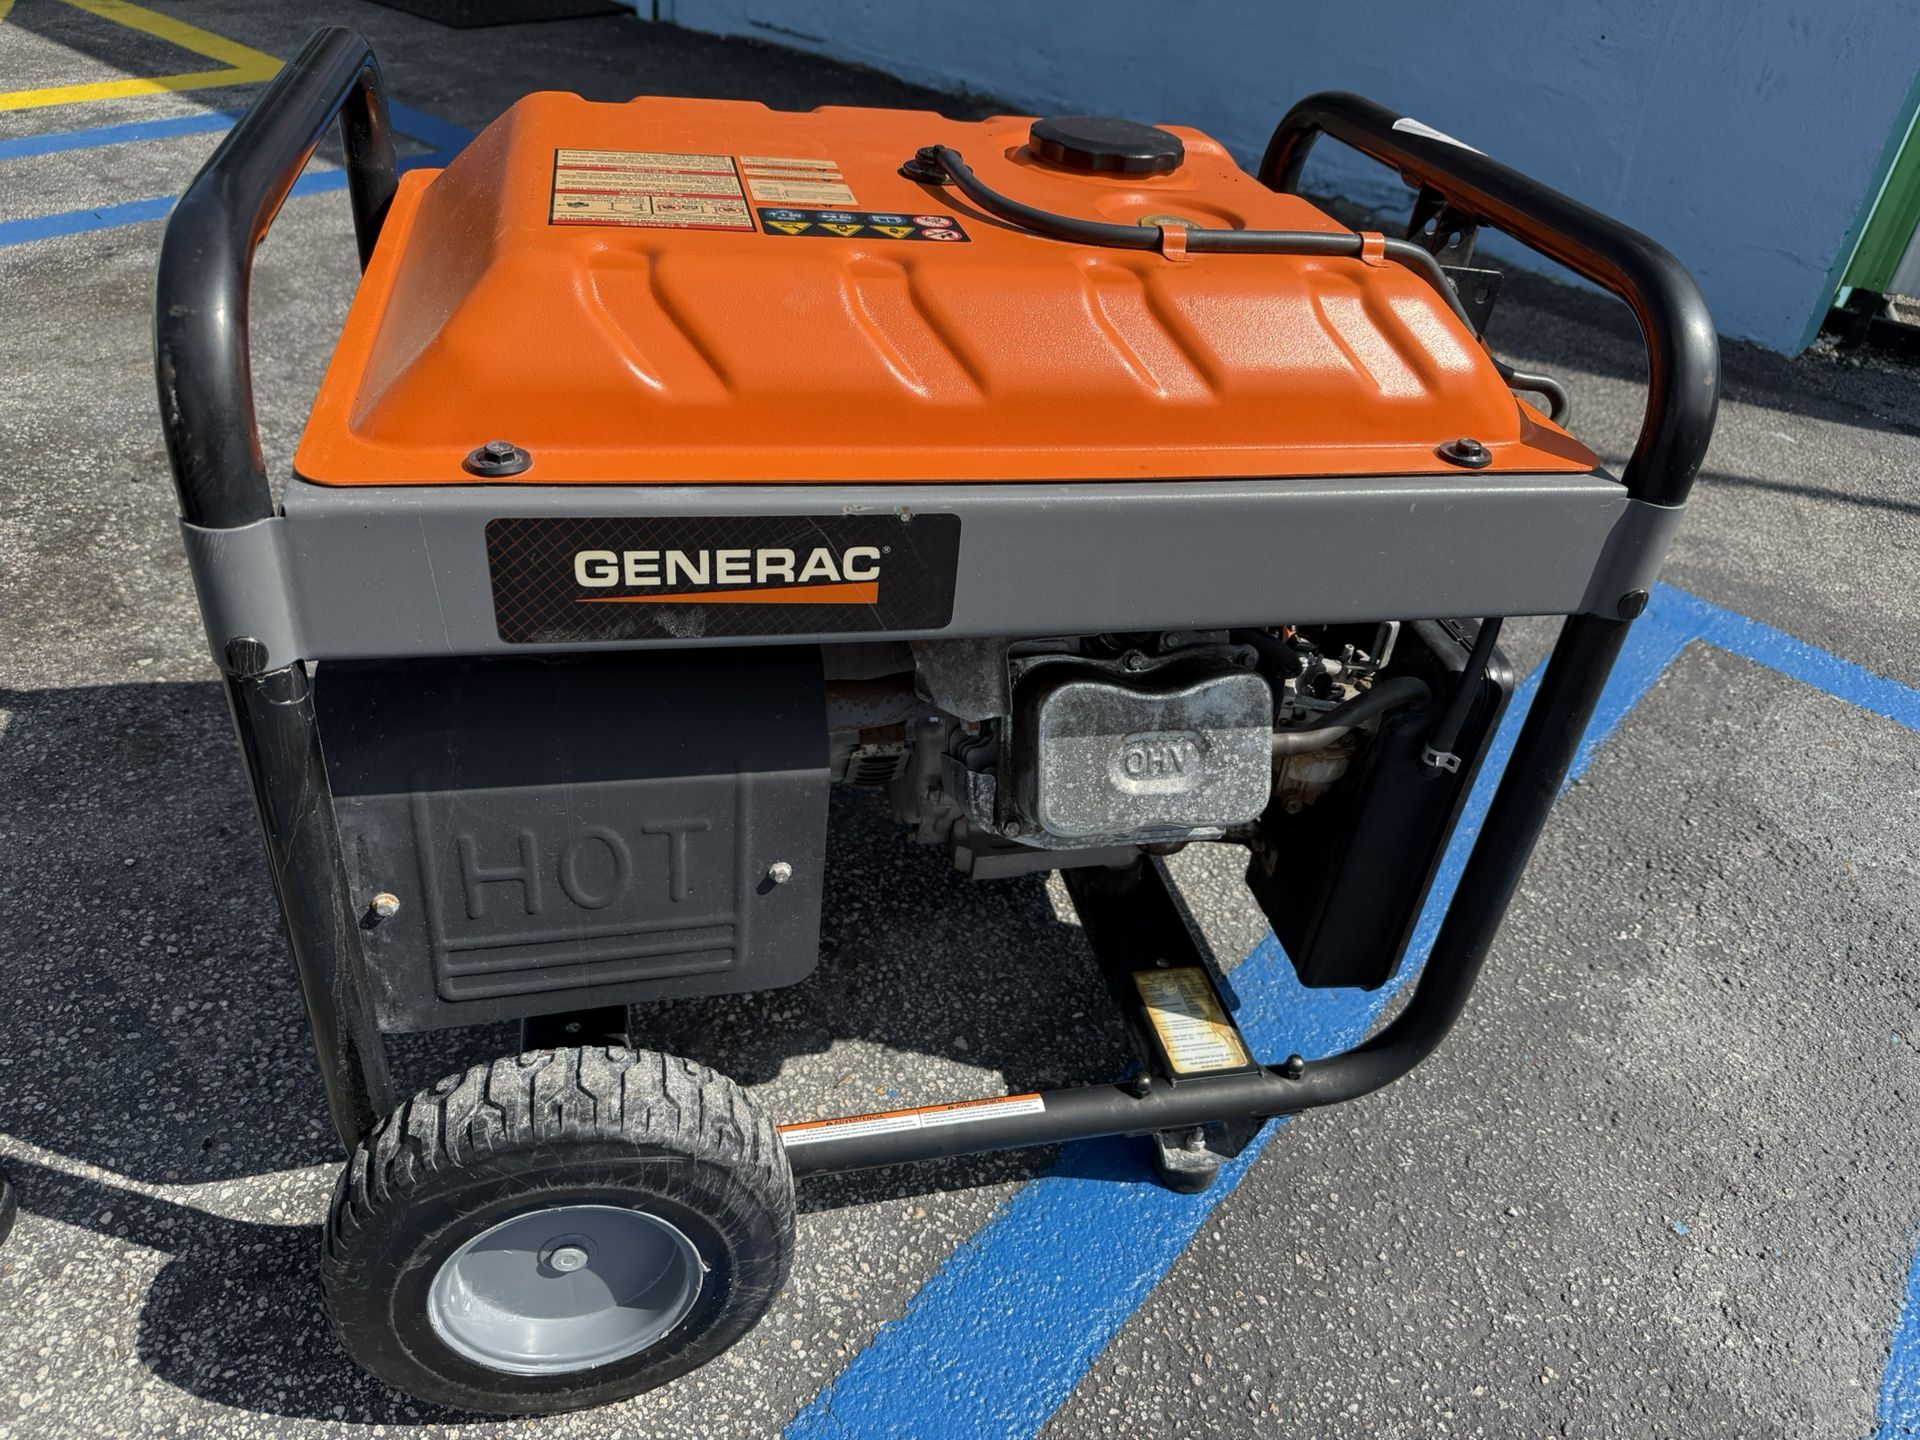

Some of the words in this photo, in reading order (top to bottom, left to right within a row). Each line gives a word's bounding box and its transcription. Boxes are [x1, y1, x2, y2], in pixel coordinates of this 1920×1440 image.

[573, 546, 881, 587] GENERAC
[1122, 741, 1187, 776] OHV
[457, 817, 714, 920] HOT
